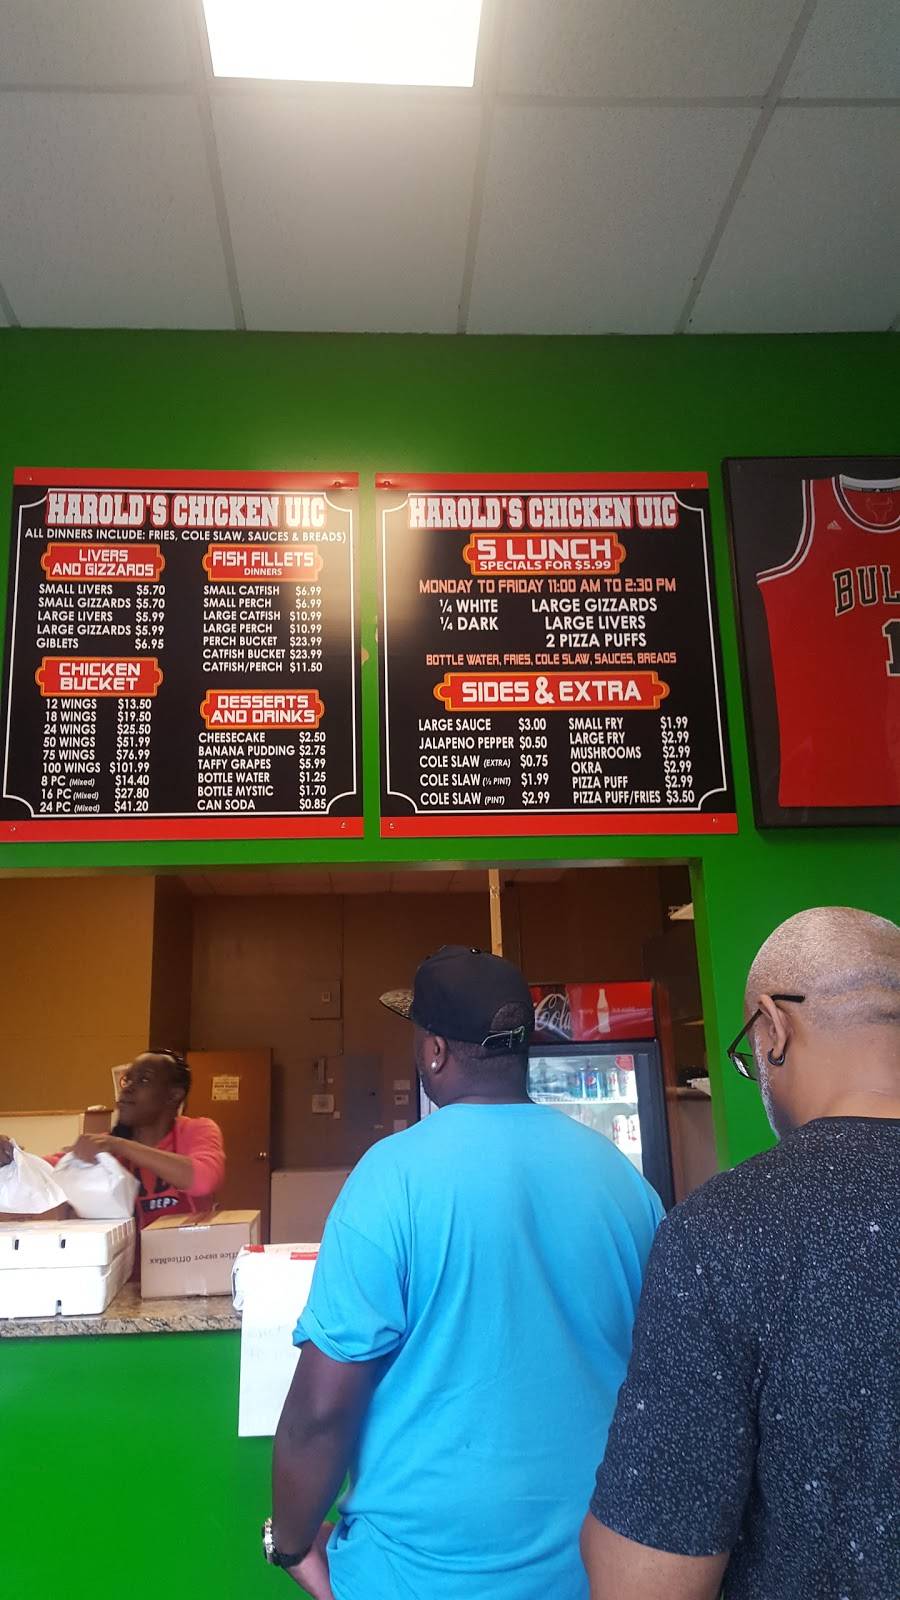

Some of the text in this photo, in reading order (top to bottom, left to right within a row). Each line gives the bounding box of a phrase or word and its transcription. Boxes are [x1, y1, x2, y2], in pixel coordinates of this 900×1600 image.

[47, 493, 325, 527] HAROLD'S CHICKEN UIC
[409, 497, 677, 529] HAROLD'S CHICKEN UIC
[25, 528, 346, 543] ALL DINNERS INCLUDE: FRIES, COLE SLAW, SAUCES & BREADS)
[79, 549, 128, 562] LIVERS
[477, 538, 611, 560] 5 LUNCH
[212, 551, 314, 566] FISH FILLETS
[480, 560, 611, 570] SPECIALS FOR $5.99
[52, 563, 154, 576] AND GIZZARDS
[244, 568, 282, 576] DINNERS
[38, 584, 166, 596] SMALL LIVERS $5.70
[203, 585, 322, 597] SMALL CATFISH $6.99
[419, 578, 676, 593] MONDAY TO FRIDAY 11:00 AM TO 2:30 PM
[203, 598, 322, 609] SMALL PERCH $6.99
[456, 599, 498, 613] WHITE
[532, 598, 657, 612] LARGE GIZZARDS
[38, 611, 165, 623] LARGE LIVERS $5.99
[203, 611, 322, 622] LARGE CATFISH $10.99
[545, 616, 646, 630] LARGE LIVERS
[457, 617, 499, 630] DARK
[36, 625, 164, 637] LARGE GIZZARDS $5.99
[36, 638, 164, 650] GIBLETS $6.95
[203, 636, 322, 648] PERCH BUCKET $23.99
[546, 633, 647, 647] 2 PIZZA PUFFS
[202, 649, 322, 660] CATFISH BUCKET $23.99
[426, 652, 676, 666] BOTTLE WATER, FRIES, COLE SLAW, SAUCES, BREADS
[59, 663, 141, 676] CHICKEN
[202, 662, 322, 673] CATFISH/PERCH $11.50
[60, 677, 138, 690] BUCKET
[462, 676, 642, 704] SIDES & EXTRA
[46, 698, 152, 711] 12 WINGS $13.50
[217, 695, 308, 709] DESSERTS
[210, 710, 315, 723] AND DRINKS
[418, 718, 546, 732] LARGE SAUCE $3.00
[568, 716, 688, 731] SMALL FRY $1.99
[199, 731, 326, 743] CHEESECAKE $2.50
[418, 736, 547, 750] JALAPENO PEPPER $0.50
[570, 731, 689, 745] LARGE FRY $2.99
[198, 745, 326, 757] BANANA PUDDING $2.75
[570, 746, 690, 760] MUSHROOMS $2.99
[42, 761, 150, 774] 100 WINGS $101.99
[198, 758, 326, 770] TAFFY GRAPES $5.99
[419, 754, 548, 768] COLE SLAW (EXTRA) $0.75
[571, 760, 692, 774] OKRA $2.99
[41, 775, 149, 787] 8 PC (Mixed) $14.40
[41, 788, 149, 801] 16 PC (Mixed) $27.80
[198, 785, 326, 797] BOTTLE MYSTIC $1.70
[573, 789, 695, 804] PIZZA PUFF/FRIES $3.50
[197, 798, 326, 810] CAN SODA $0.85
[420, 791, 550, 806] COLE SLAW (PINT) $2.99
